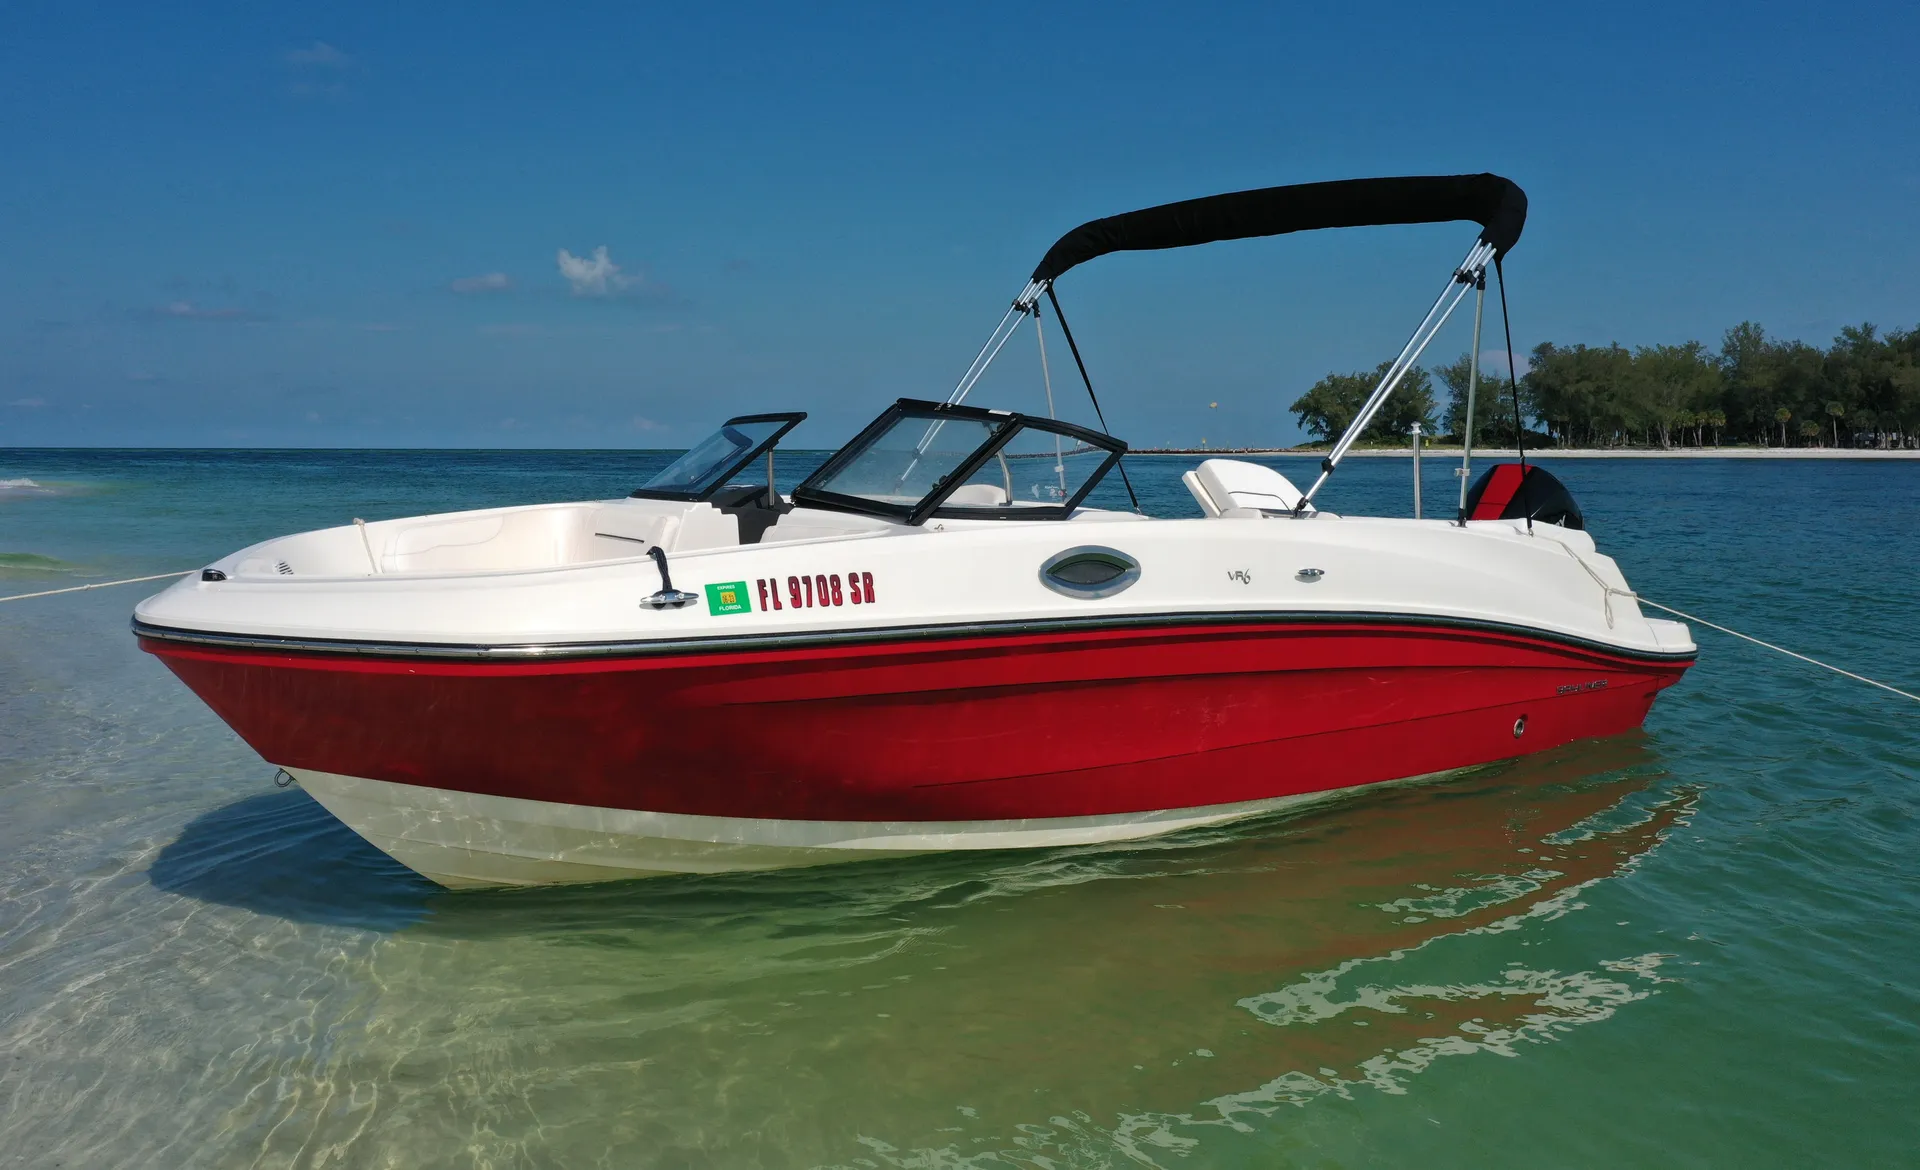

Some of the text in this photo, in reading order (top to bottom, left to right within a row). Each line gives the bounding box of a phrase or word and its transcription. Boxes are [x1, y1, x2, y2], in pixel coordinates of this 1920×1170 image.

[1227, 568, 1251, 585] VR6
[757, 571, 875, 611] FL 9708 SR
[718, 604, 742, 612] FLORIDA
[1556, 679, 1608, 695] BAYLINER
